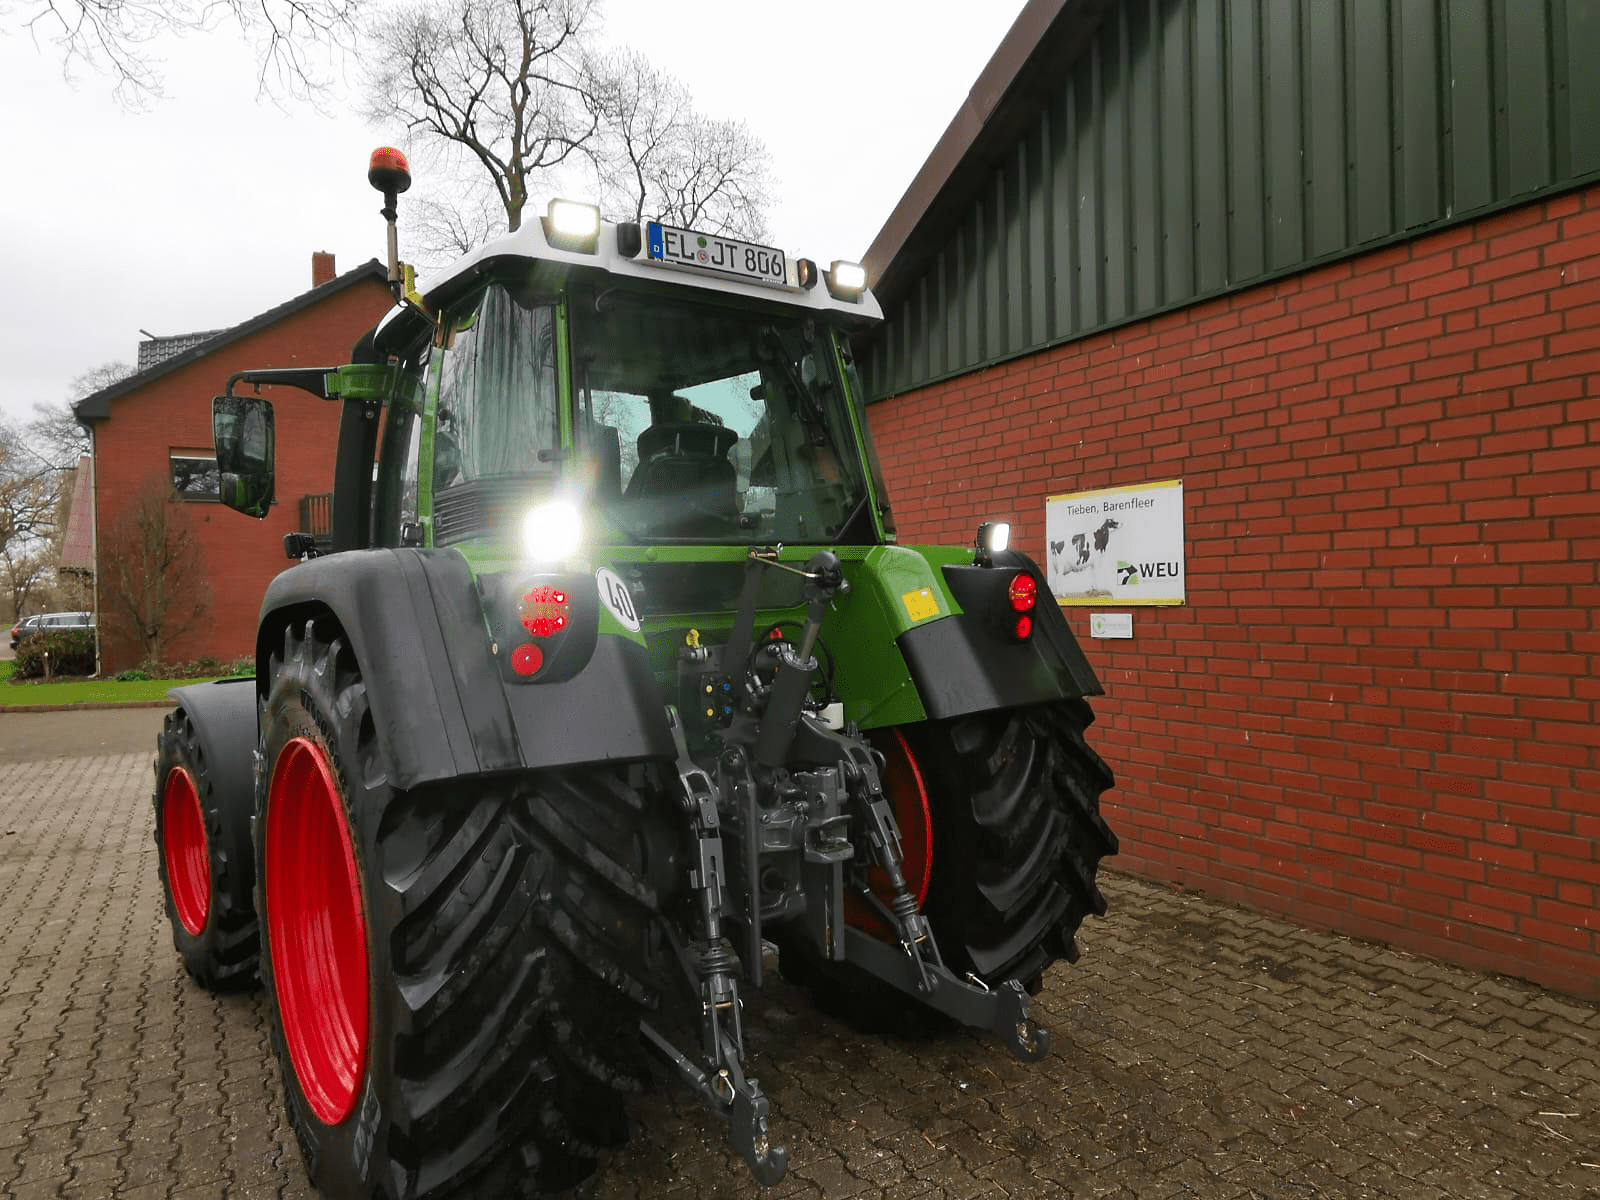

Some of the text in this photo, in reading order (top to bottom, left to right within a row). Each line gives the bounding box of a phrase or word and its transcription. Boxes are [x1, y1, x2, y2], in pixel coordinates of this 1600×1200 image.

[664, 231, 782, 276] EL JT 806
[1067, 497, 1155, 516] Tieben, Barenfleer
[1139, 562, 1178, 578] WEU
[604, 576, 635, 622] 40
